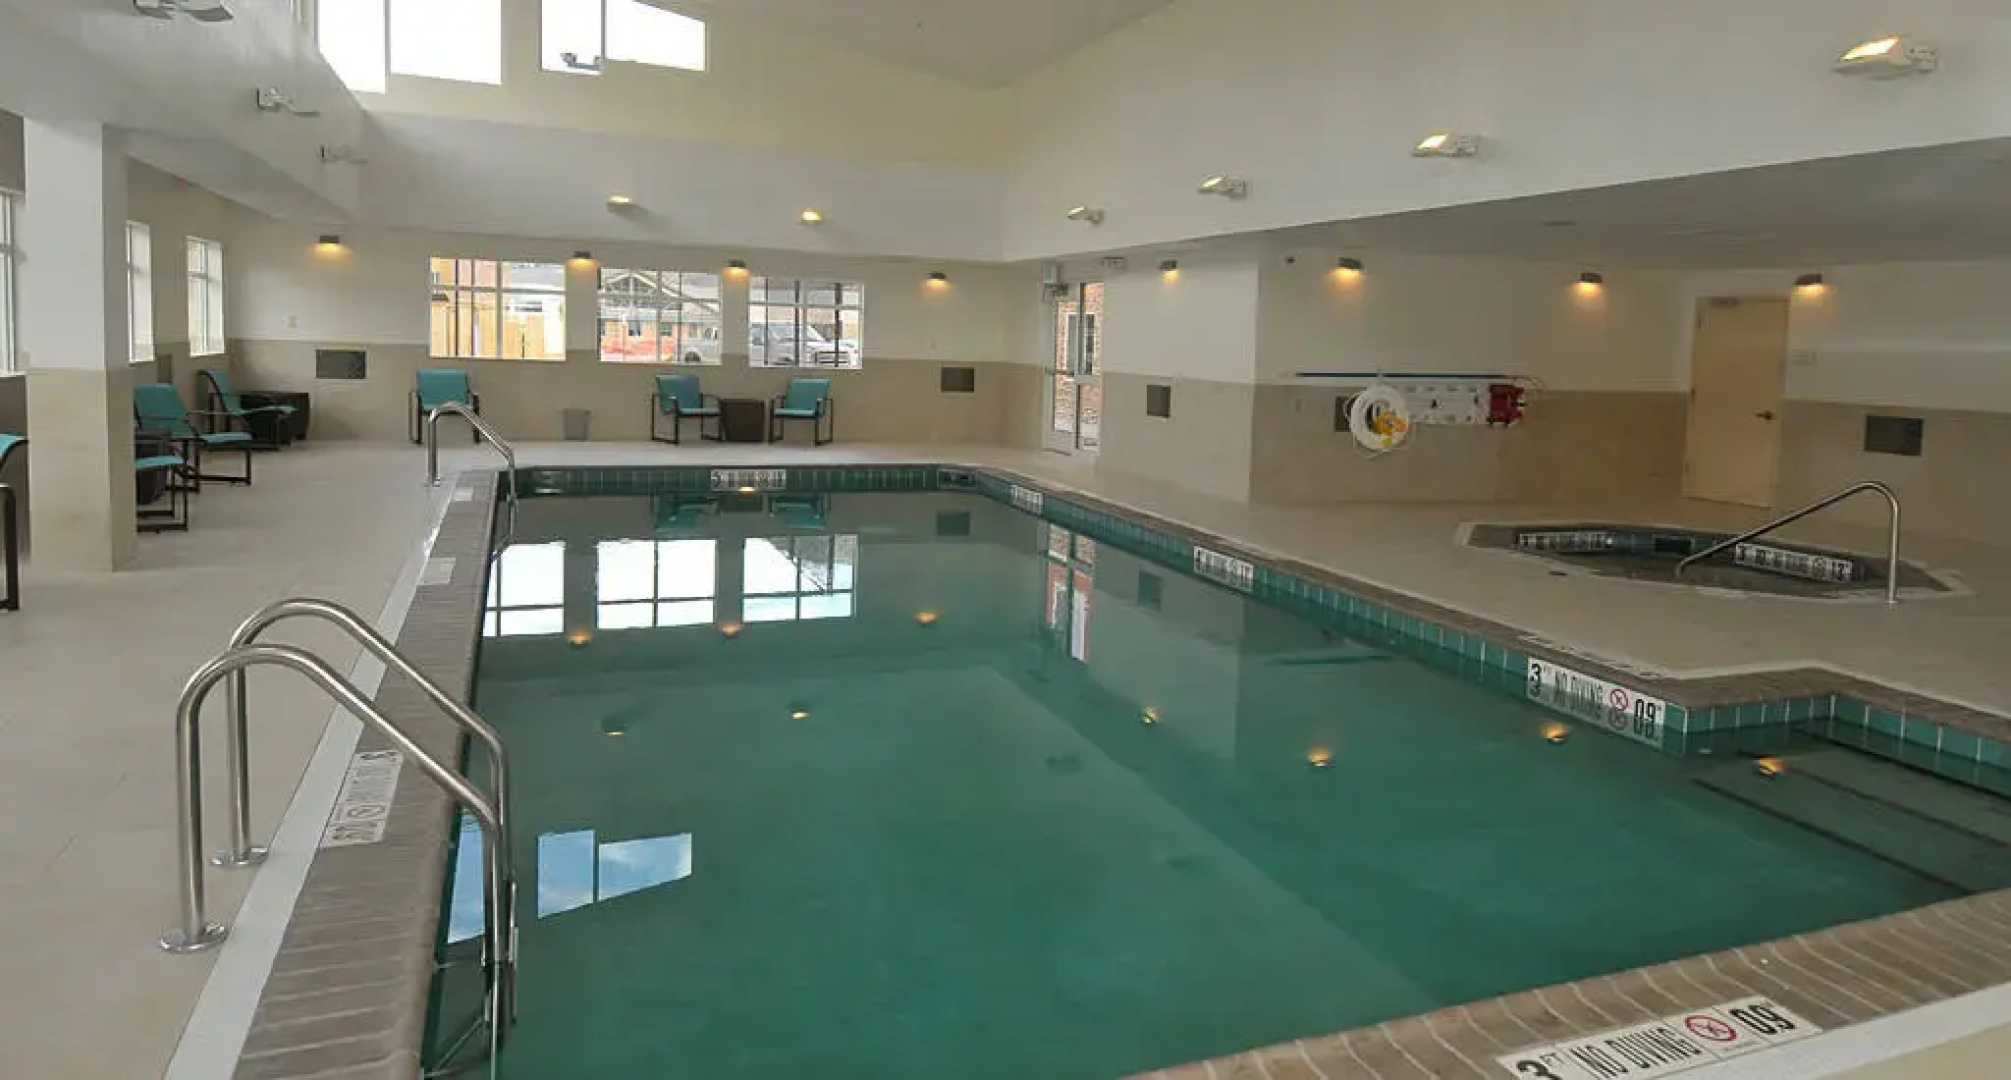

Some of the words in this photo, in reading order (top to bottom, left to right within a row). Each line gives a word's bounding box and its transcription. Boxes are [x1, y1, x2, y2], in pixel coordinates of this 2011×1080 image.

[1531, 663, 1541, 681] 3
[1569, 1045, 1628, 1079] NO
[1604, 1028, 1702, 1069] DIVING
